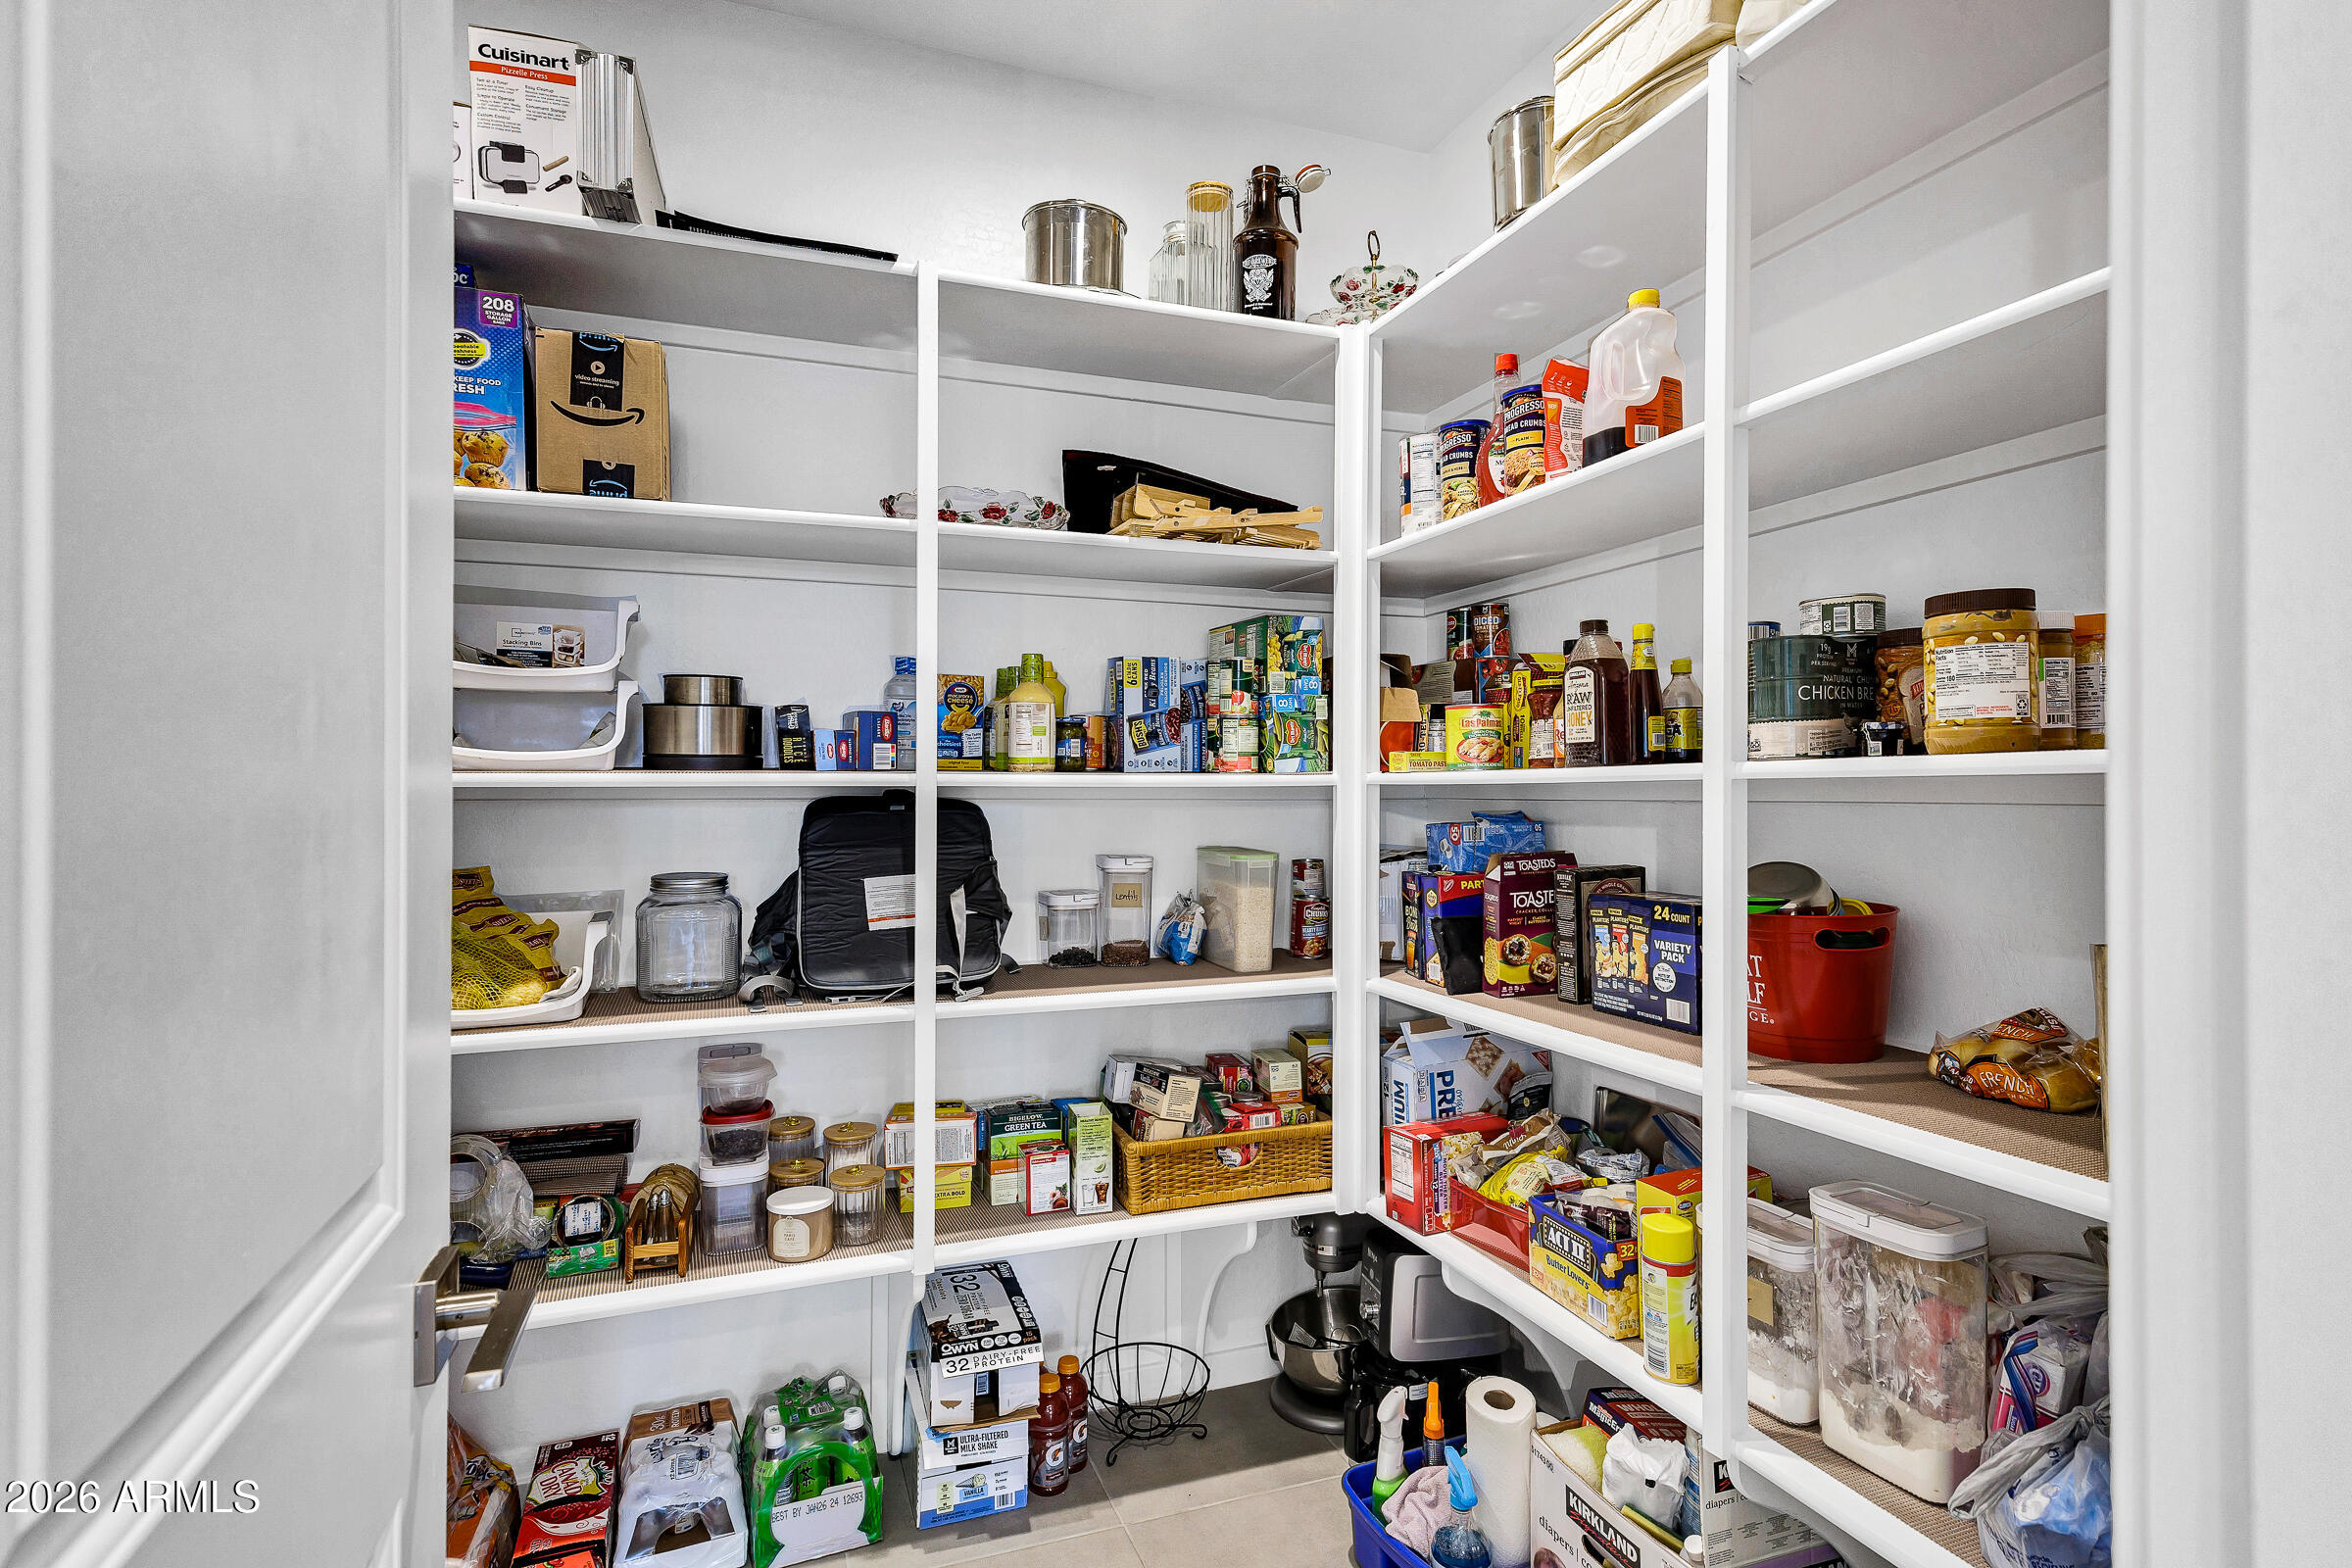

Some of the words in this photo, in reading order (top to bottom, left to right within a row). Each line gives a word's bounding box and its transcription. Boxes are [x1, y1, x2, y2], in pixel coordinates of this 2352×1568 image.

[478, 43, 569, 71] Cuisinart
[501, 67, 528, 76] Pizzelle
[529, 70, 549, 79] Press
[482, 296, 515, 313] 208
[484, 310, 513, 318] STORAGE
[574, 373, 591, 382] video
[591, 376, 620, 386] streaming
[454, 383, 485, 395] RESH
[1449, 451, 1473, 460] CRUMBS
[1473, 615, 1500, 626] DICED
[503, 638, 528, 647] Stacking
[1820, 643, 1832, 654] 19g
[1309, 680, 1318, 689] 8
[1823, 674, 1853, 683] NATURAL
[1567, 692, 1592, 705] RAW
[1797, 685, 1855, 701] CHICKEN
[1857, 686, 1875, 700] BRE
[1278, 699, 1288, 708] 8
[1461, 718, 1475, 727] Las
[1567, 711, 1592, 727] HONEY
[1134, 720, 1148, 748] BUSH'S
[782, 737, 793, 763] NOODLES
[793, 737, 804, 762] RICE
[1450, 826, 1459, 842] 50
[1516, 858, 1556, 872] TOASTEDS
[1460, 880, 1485, 890] PART
[1115, 891, 1139, 903] Lentils
[1509, 890, 1555, 908] TOASTE
[1653, 905, 1671, 921] 24
[1670, 913, 1690, 924] COUNT
[1629, 923, 1649, 933] PLANTERS
[1653, 939, 1692, 955] VARIETY
[1661, 951, 1686, 963] PACK
[1747, 981, 1766, 1004] LF
[1748, 1010, 1769, 1024] GE
[1995, 1024, 2034, 1040] ENCH
[1979, 1071, 2034, 1096] FRENCH
[1004, 1122, 1031, 1133] GREEN
[1431, 1180, 1440, 1190] 12
[1546, 1227, 1569, 1252] ACT
[1570, 1238, 1587, 1262] II
[1620, 1245, 1634, 1258] 32
[1545, 1253, 1567, 1274] Butter
[1567, 1266, 1591, 1291] Lovers
[950, 1274, 981, 1294] 32
[1022, 1335, 1038, 1344] pack
[941, 1340, 980, 1356] OWYN
[946, 1357, 970, 1374] 32
[972, 1346, 1041, 1363] DAIRY-FREE
[974, 1355, 1024, 1369] PROTEIN
[1616, 1403, 1663, 1413] WHOL
[959, 1431, 1009, 1445] ULTRA-FILTERED
[959, 1444, 977, 1453] MILK
[977, 1441, 999, 1451] SHAKE
[552, 1459, 583, 1495] CANAD
[540, 1475, 563, 1498] DRY
[963, 1487, 985, 1496] VANILLA
[772, 1510, 788, 1524] BEST
[792, 1507, 802, 1518] BY
[806, 1500, 827, 1515] JAN26
[830, 1497, 839, 1507] 24
[843, 1492, 863, 1505] 12693
[1705, 1494, 1736, 1509] diapers
[1569, 1492, 1639, 1563] KIRKLAND
[1539, 1516, 1575, 1556] diapers
